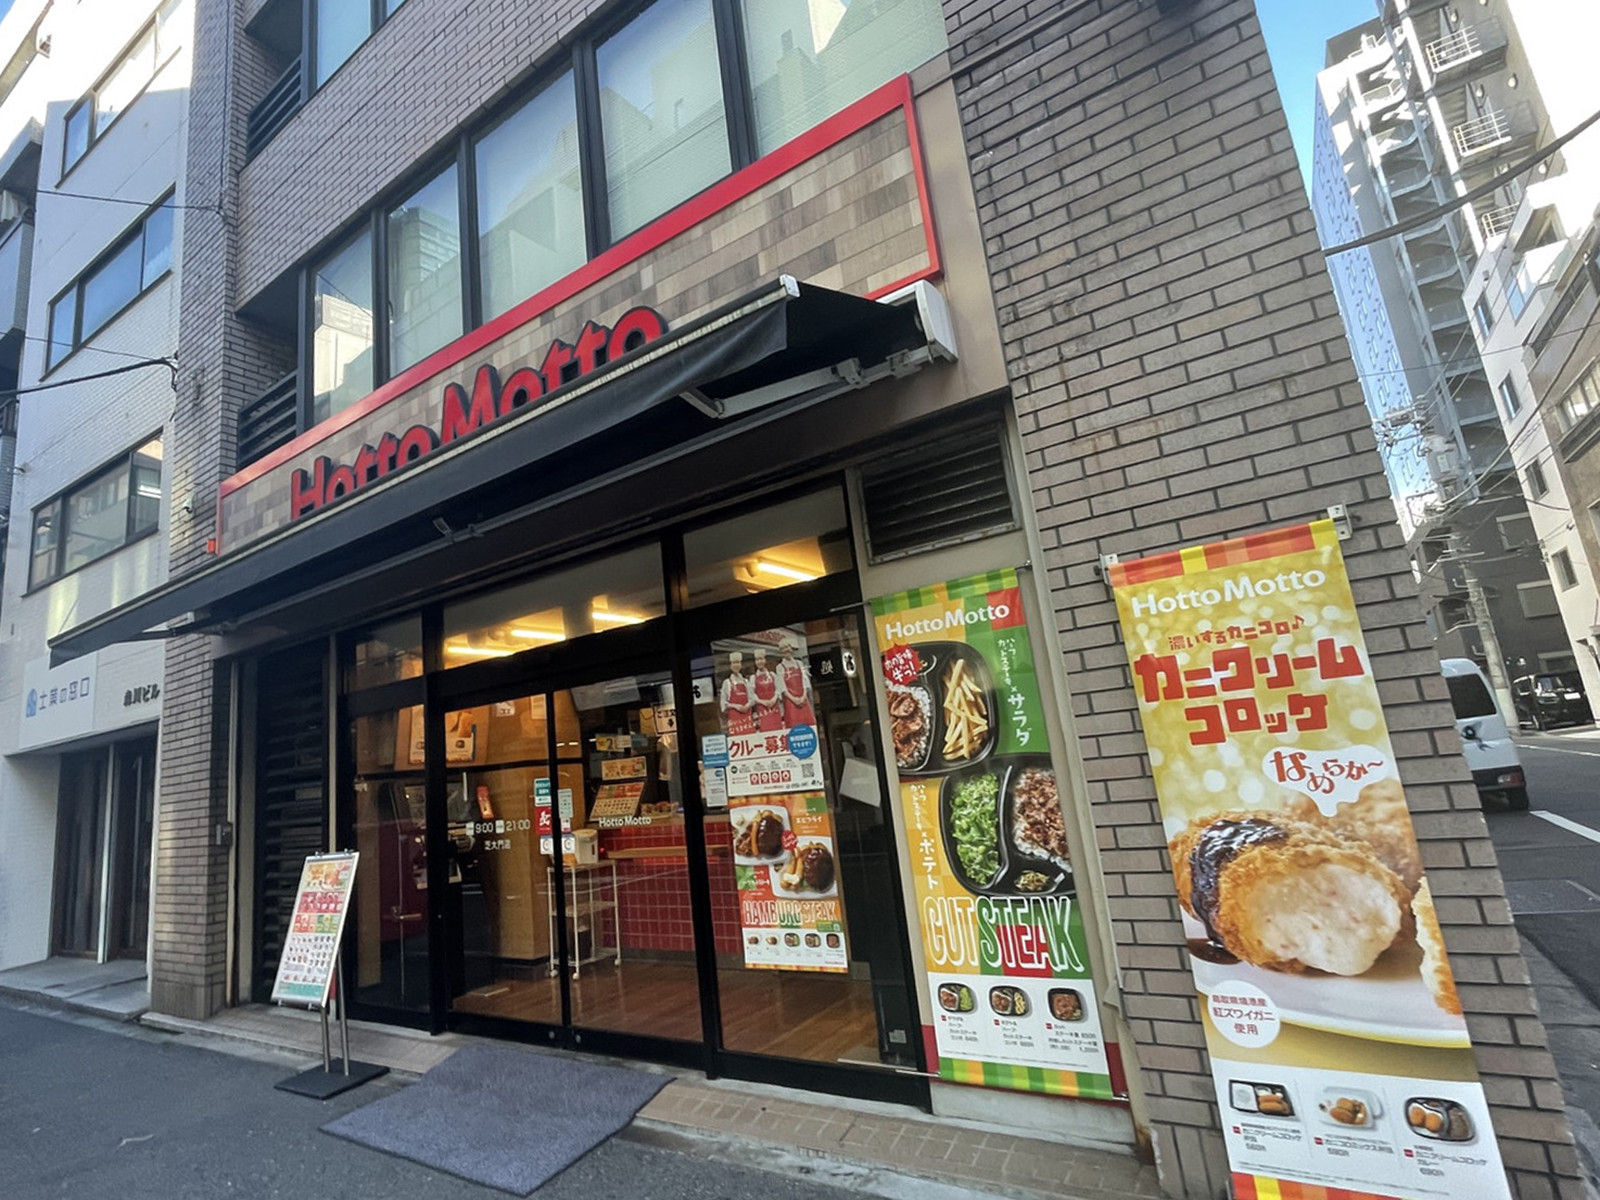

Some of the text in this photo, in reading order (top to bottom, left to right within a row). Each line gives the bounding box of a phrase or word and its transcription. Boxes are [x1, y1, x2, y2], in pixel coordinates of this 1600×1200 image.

[1134, 638, 1364, 703] カニクリーム
[1185, 693, 1328, 745] コロッケ
[1213, 1007, 1275, 1021] 紅ズワイガニ
[1234, 1023, 1259, 1035] 使用
